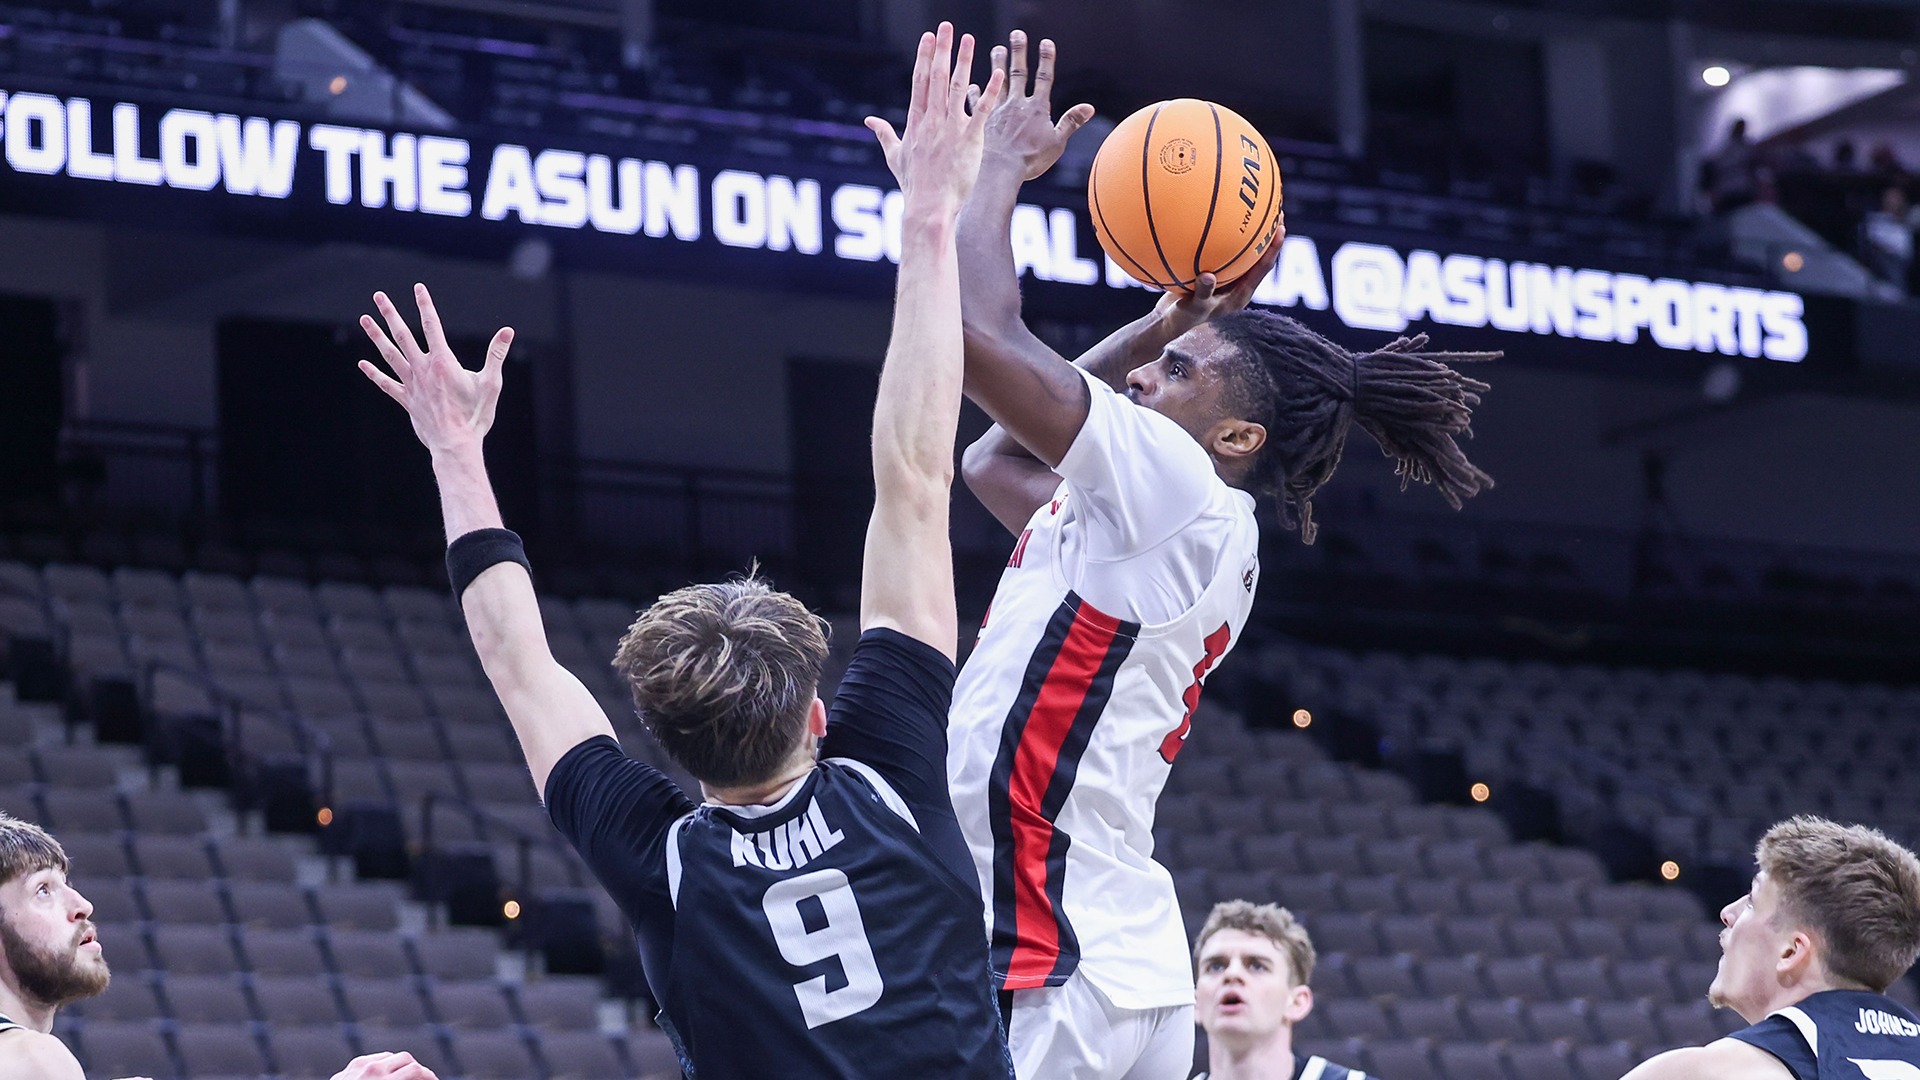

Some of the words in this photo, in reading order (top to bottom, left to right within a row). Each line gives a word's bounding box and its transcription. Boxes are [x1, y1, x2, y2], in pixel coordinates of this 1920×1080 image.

[0, 89, 300, 199] OLLOW
[309, 124, 472, 217] THE
[481, 144, 700, 241] ASUN
[712, 170, 822, 255] ON
[830, 183, 1099, 286] SAL
[1331, 241, 1809, 363] @ASUNSPORTS
[730, 796, 845, 870] KUHL
[762, 868, 884, 1030] 9
[1854, 1007, 1920, 1037] JOHNS
